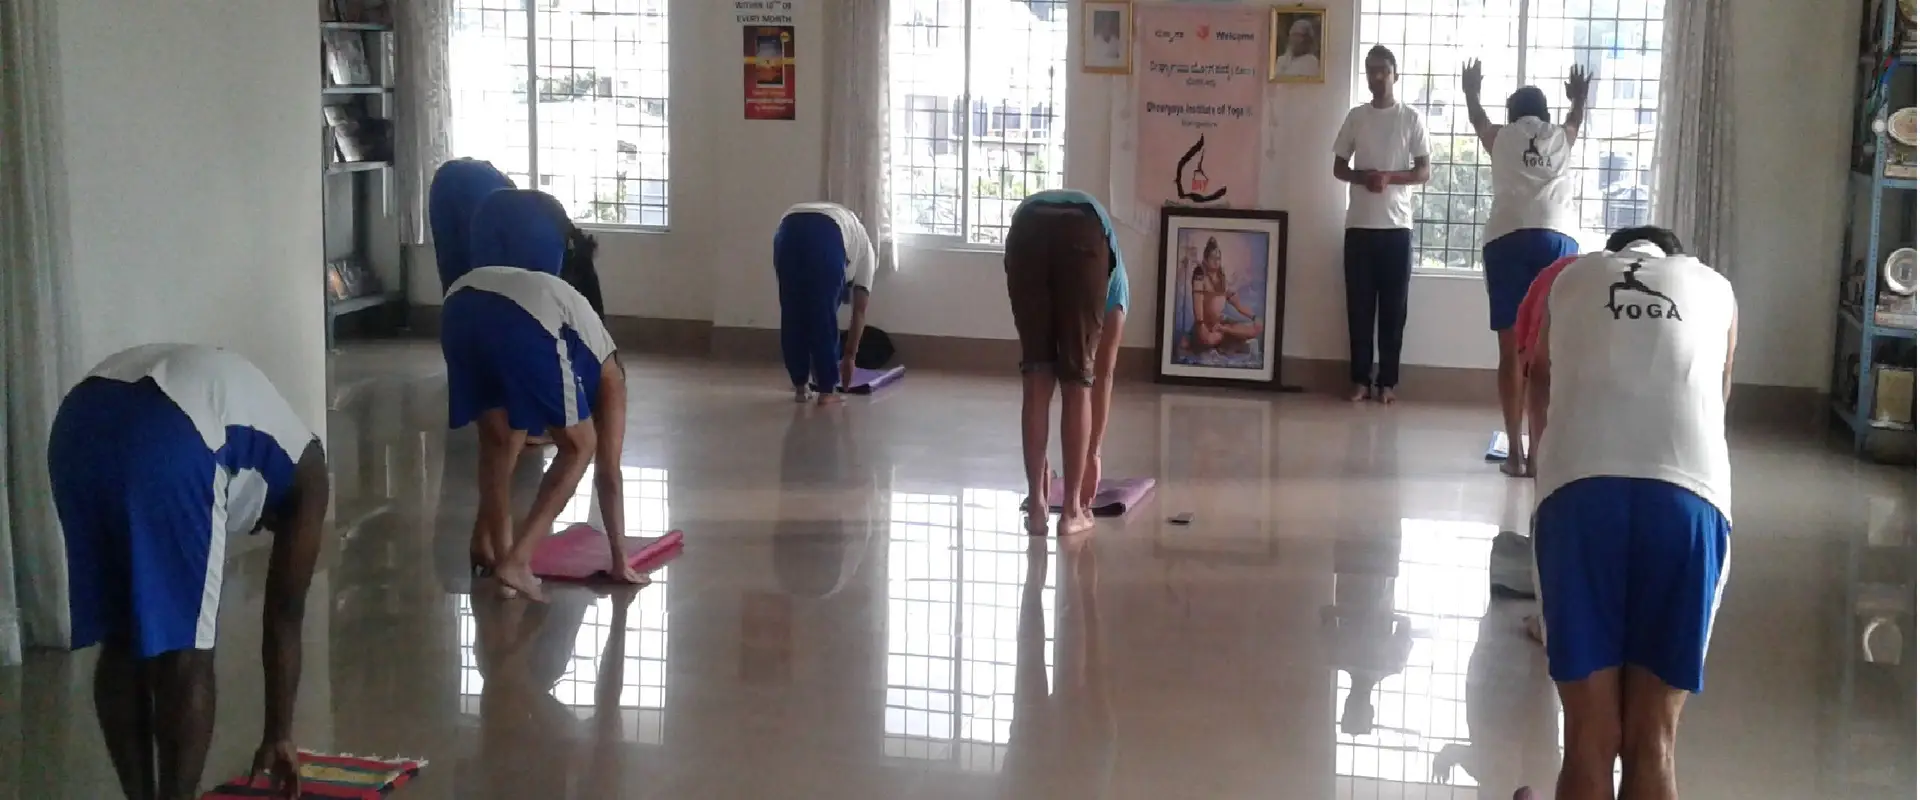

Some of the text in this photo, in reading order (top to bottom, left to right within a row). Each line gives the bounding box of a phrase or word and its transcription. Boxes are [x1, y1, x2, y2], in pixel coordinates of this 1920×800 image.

[762, 15, 792, 23] MONTH
[1215, 31, 1255, 41] Welcome
[1186, 102, 1215, 115] Institute
[1216, 103, 1225, 115] of
[1226, 104, 1244, 119] Yoga
[1608, 303, 1682, 321] YOGA
